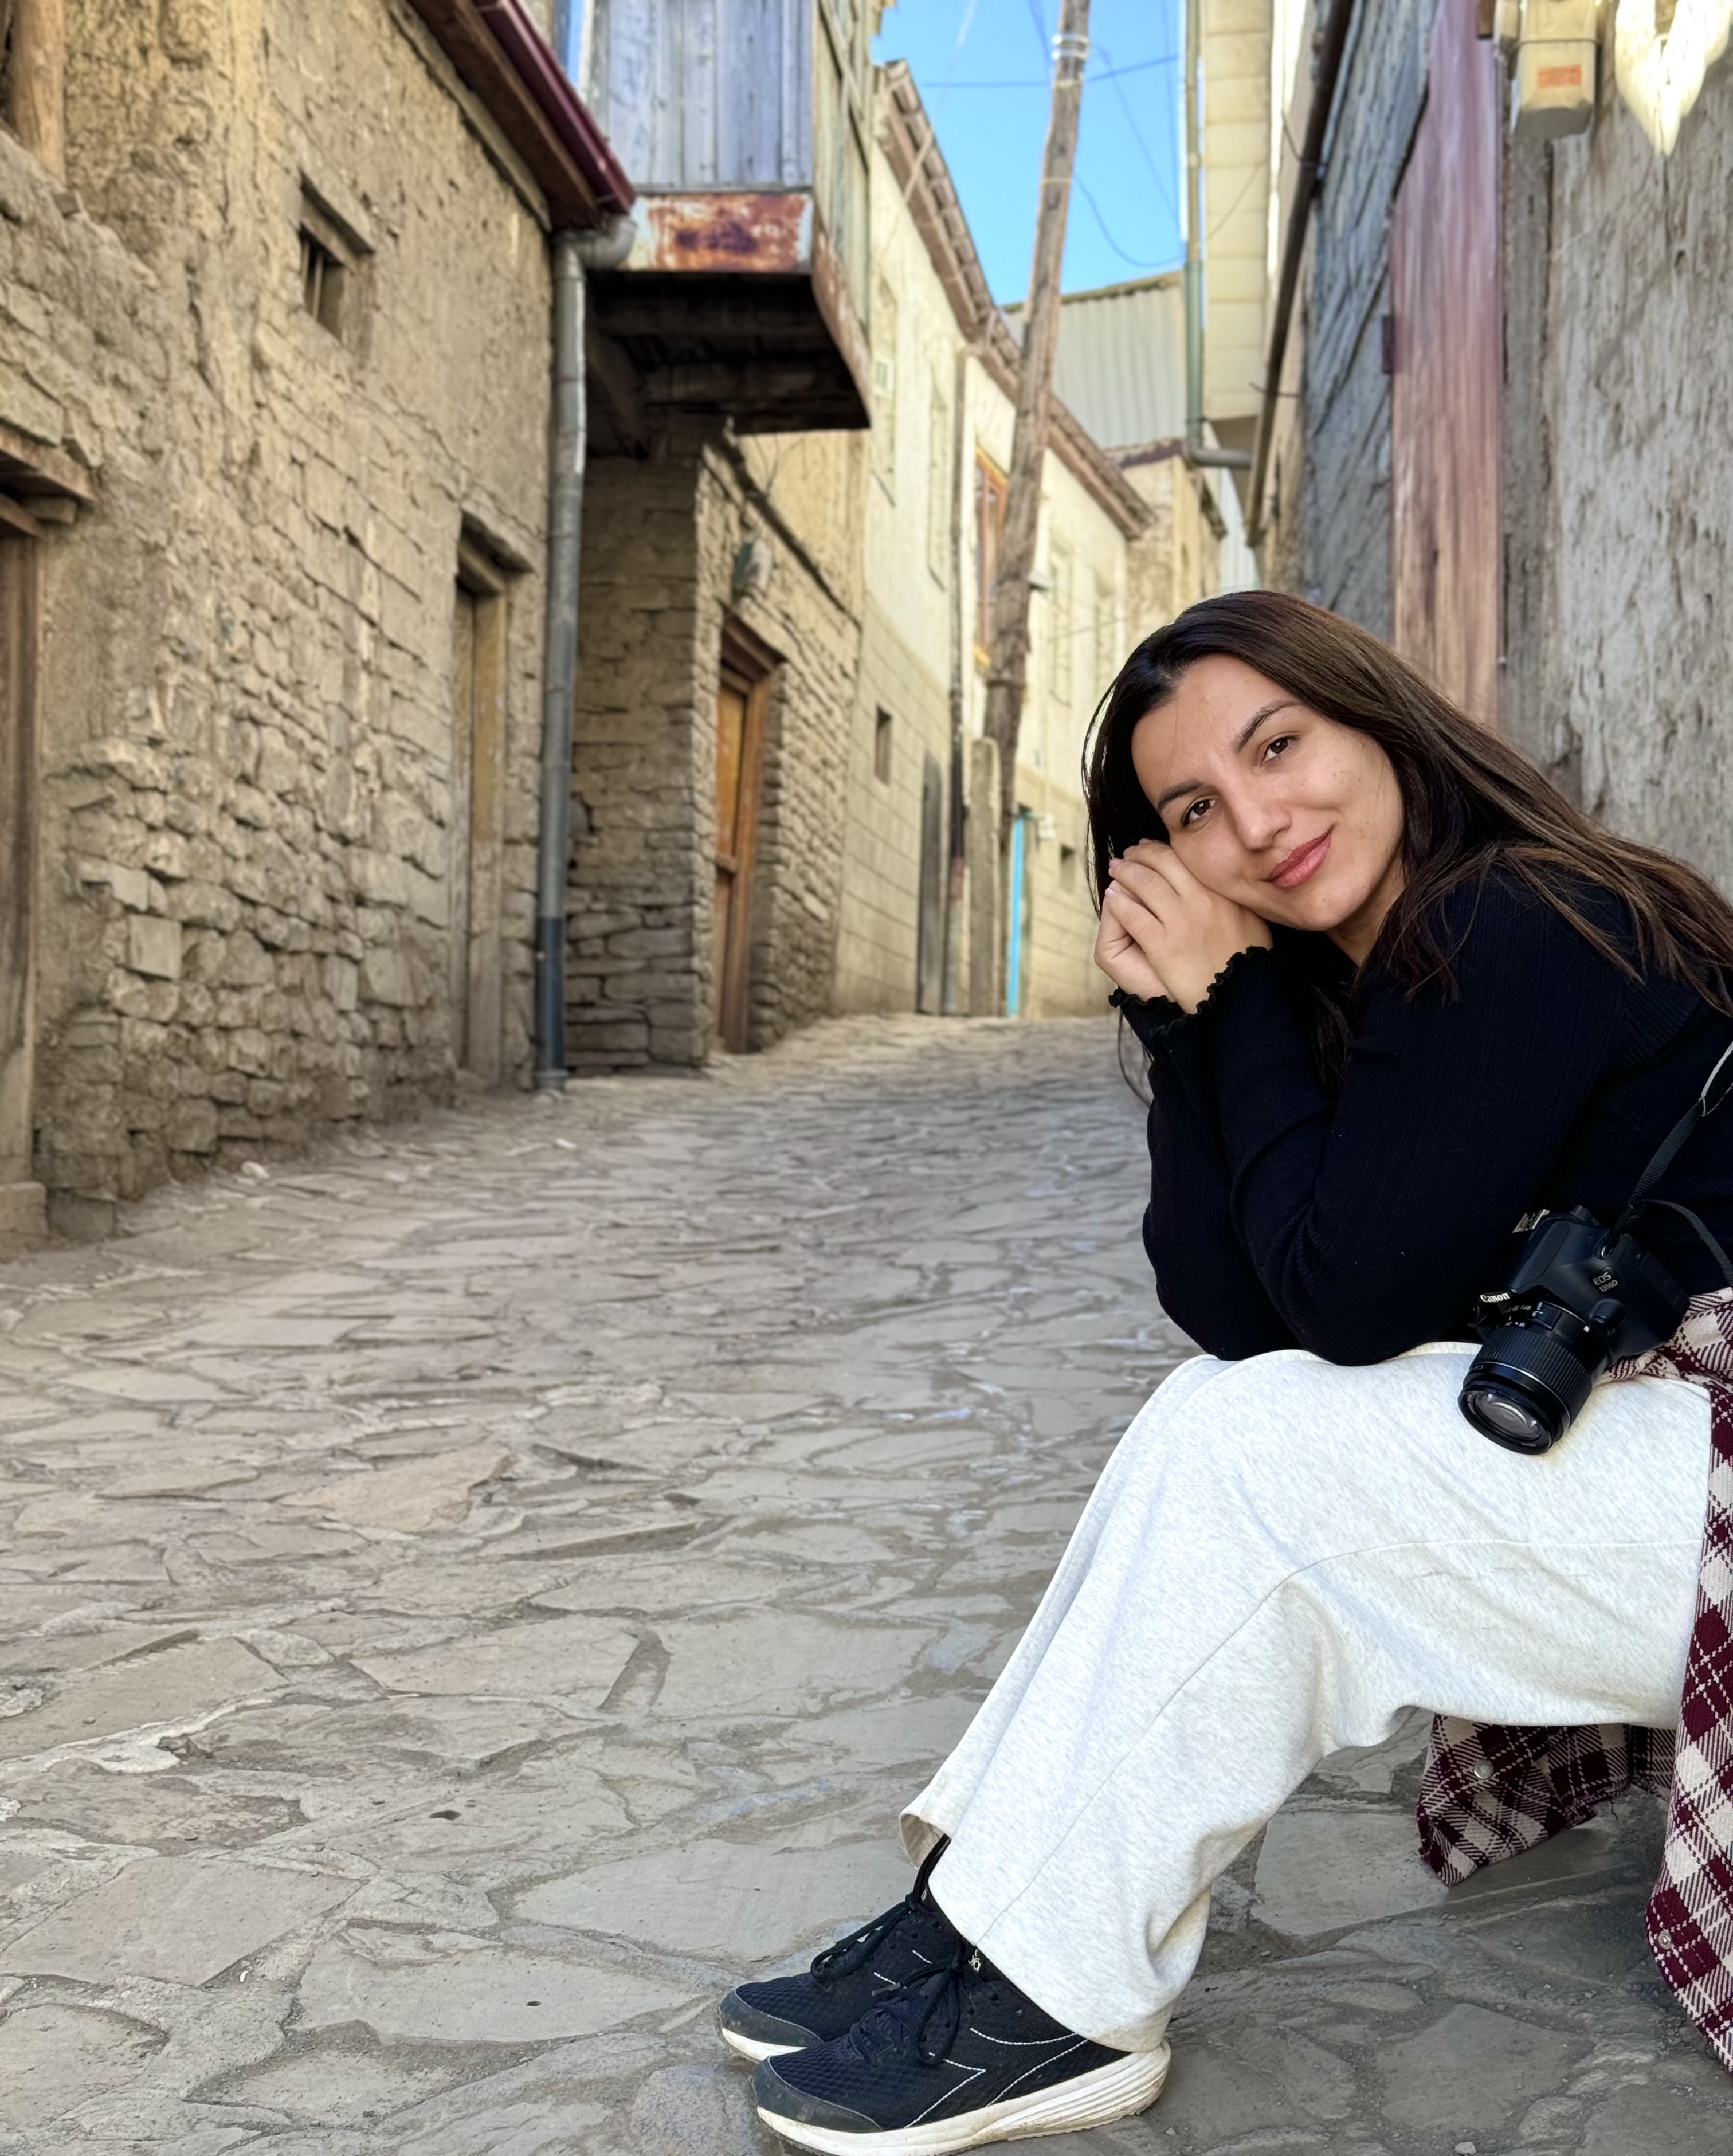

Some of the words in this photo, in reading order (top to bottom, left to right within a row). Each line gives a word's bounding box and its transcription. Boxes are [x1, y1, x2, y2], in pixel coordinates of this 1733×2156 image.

[1593, 1272, 1612, 1285] EOS
[1599, 1280, 1618, 1292] 1200D
[1480, 1292, 1511, 1303] Canon
